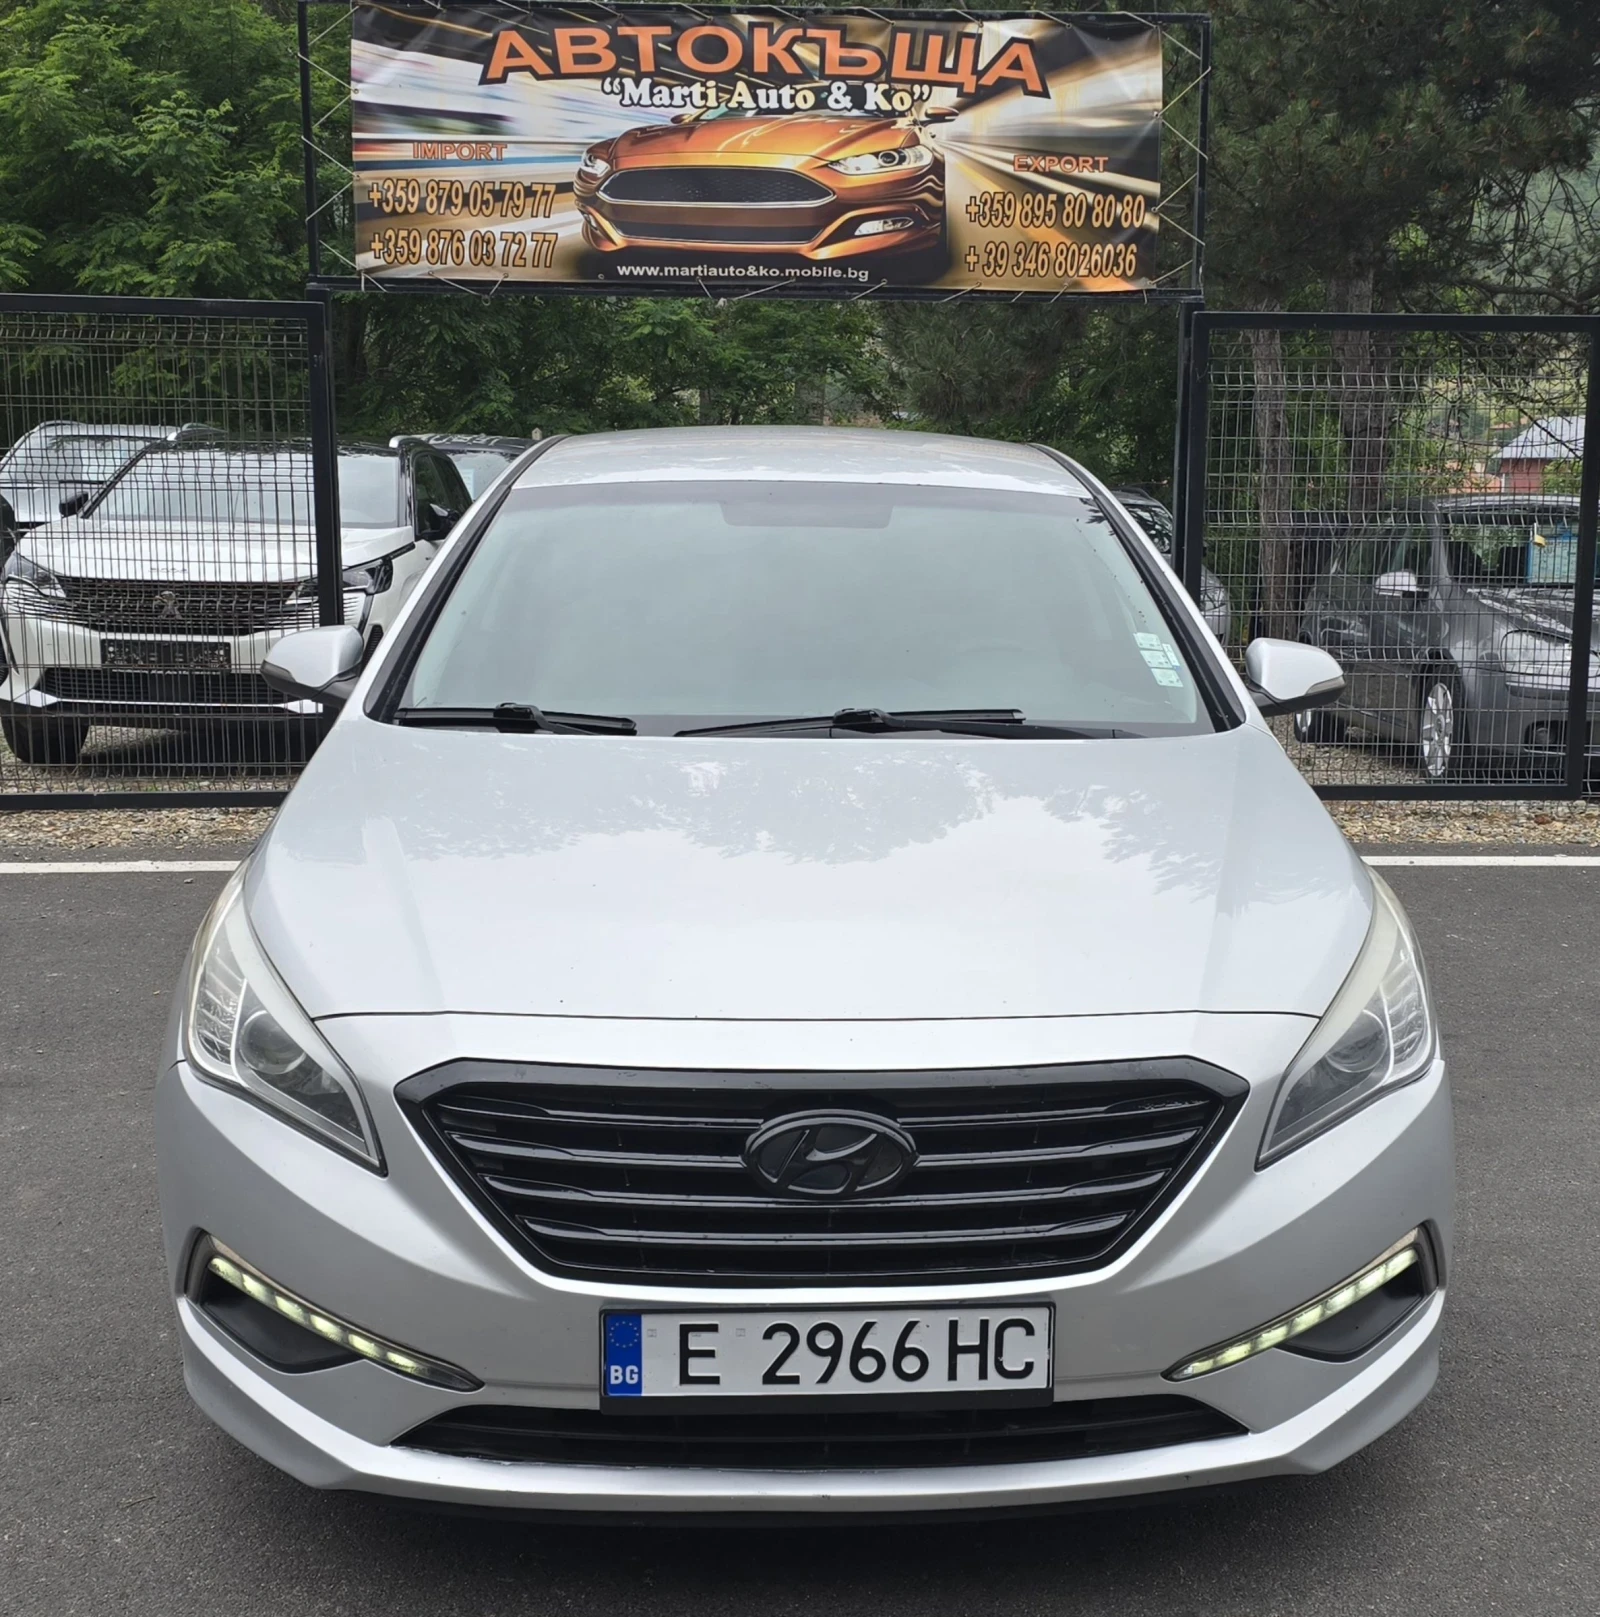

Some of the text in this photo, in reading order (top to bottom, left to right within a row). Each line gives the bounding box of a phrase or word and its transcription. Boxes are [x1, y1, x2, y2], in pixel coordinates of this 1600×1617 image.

[482, 24, 1047, 97] АВТОКЪЩА
[728, 81, 816, 110] Auto
[827, 81, 853, 111] &
[412, 142, 508, 161] IMPORT
[1013, 154, 1109, 173] EXPORT
[368, 178, 557, 219] +359 879 05 79 77
[965, 191, 1146, 230] +359 895 80 80 80
[370, 228, 558, 268] +359 876 03 72 77
[965, 241, 1138, 278] + 39 346 8026036
[616, 265, 870, 282] www.martiauto&ko.mobile.bg
[678, 1317, 1036, 1386] E 2966 HC
[609, 1364, 639, 1385] BG
